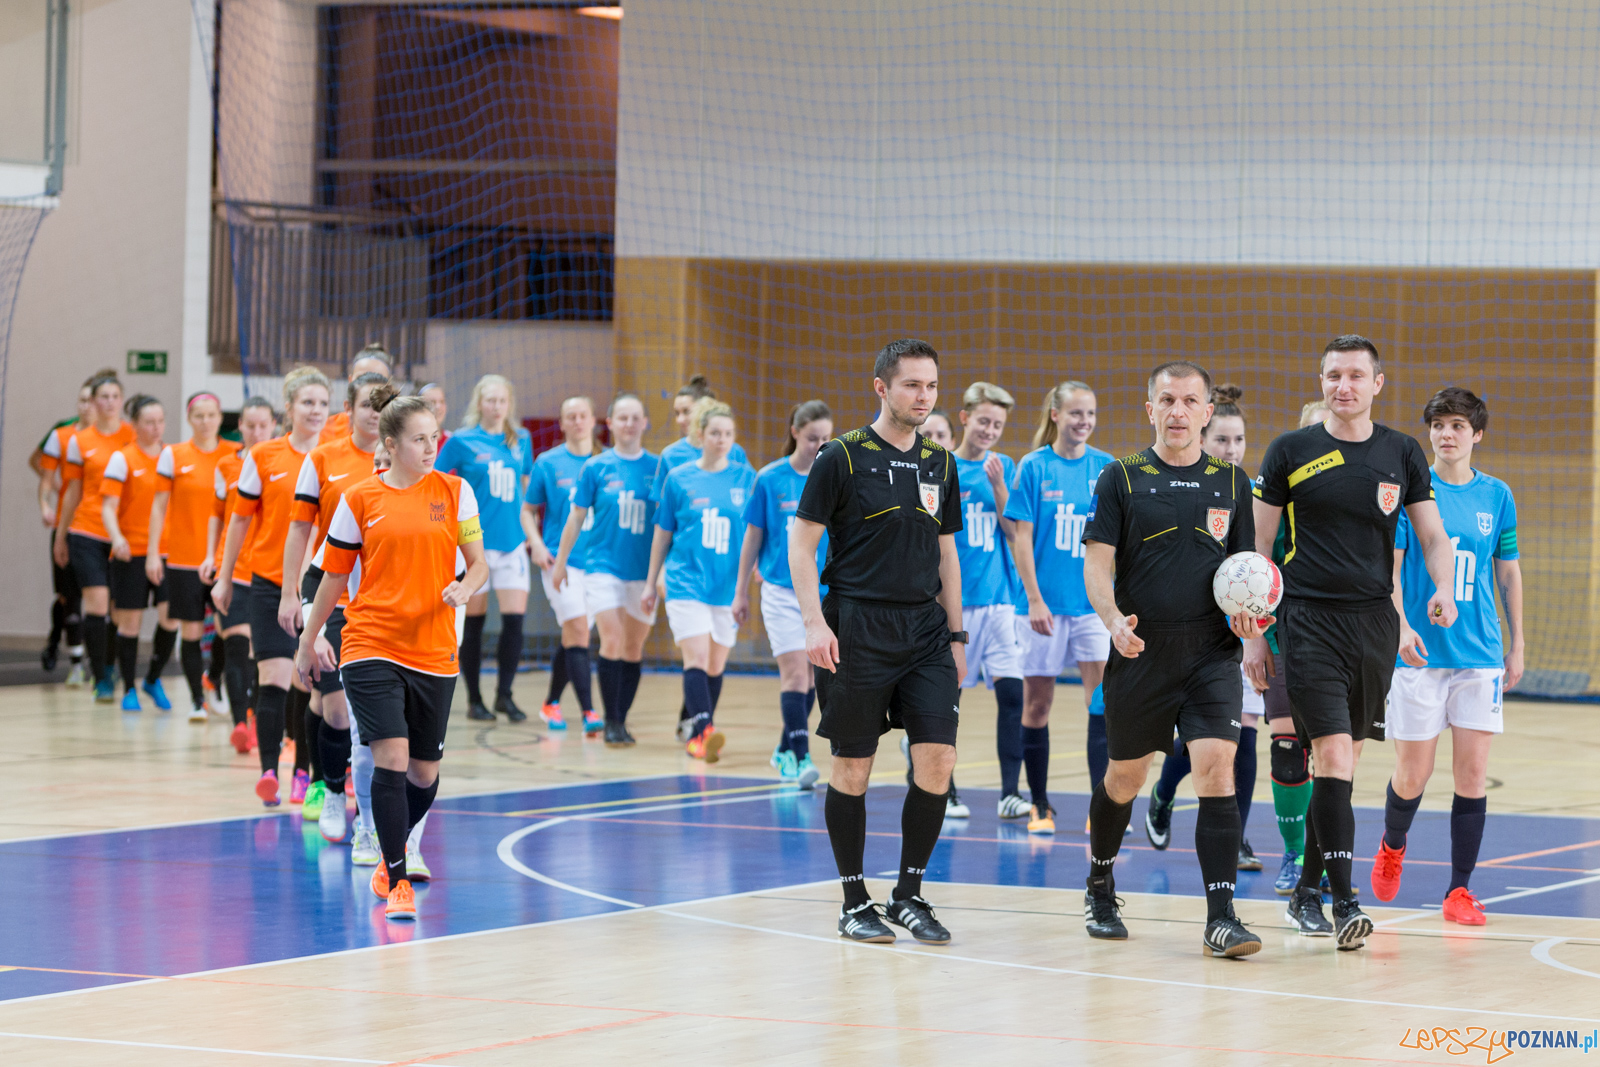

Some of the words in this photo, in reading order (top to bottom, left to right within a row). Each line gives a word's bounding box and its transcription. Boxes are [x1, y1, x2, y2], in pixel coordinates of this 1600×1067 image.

[890, 460, 919, 470] zina
[1169, 480, 1200, 488] zina
[1324, 851, 1353, 860] zina
[1208, 881, 1236, 891] zina
